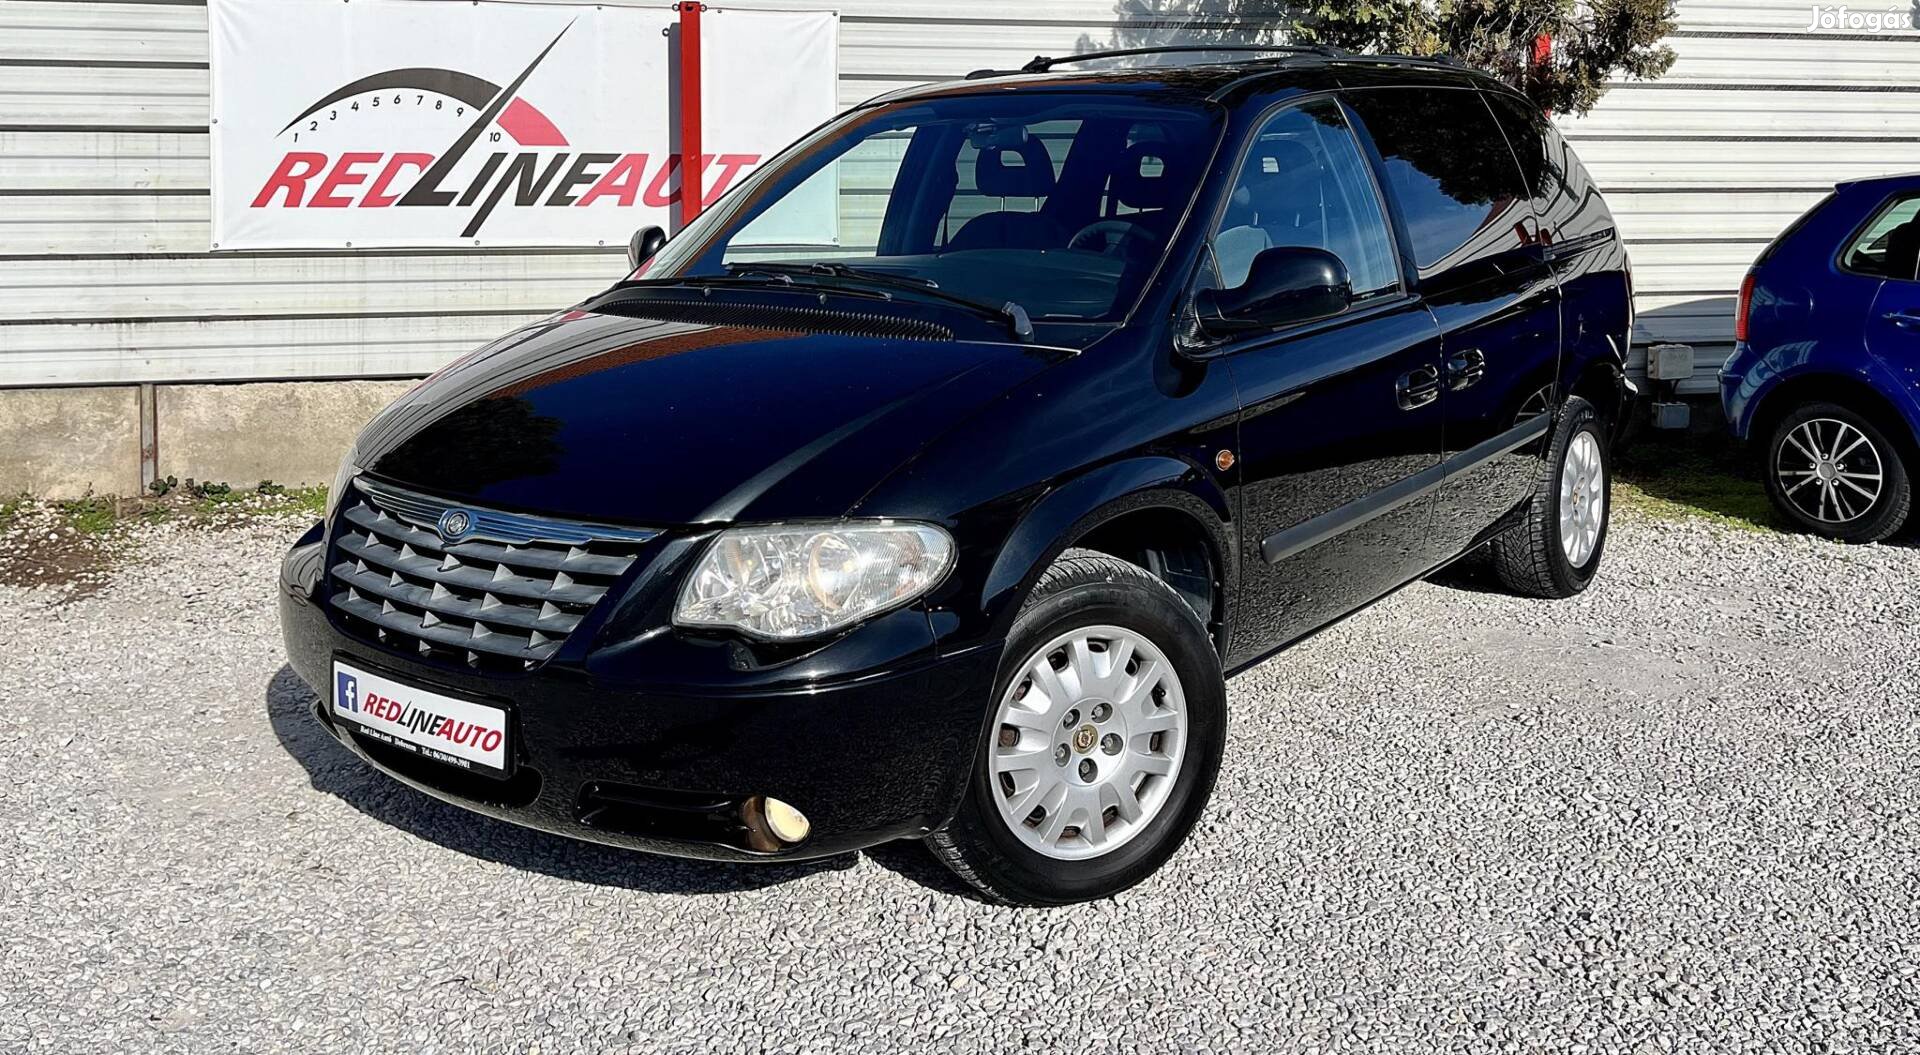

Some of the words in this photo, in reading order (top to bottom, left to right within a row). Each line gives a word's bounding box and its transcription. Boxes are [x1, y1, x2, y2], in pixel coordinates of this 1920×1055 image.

[294, 133, 299, 143] 1
[310, 121, 318, 131] 2
[329, 111, 337, 121] 3
[351, 102, 360, 111] 4
[373, 97, 380, 107] 5
[394, 95, 401, 105] 6
[416, 95, 424, 106] 7
[435, 100, 442, 110] 8
[456, 107, 464, 117] 9
[489, 132, 501, 143] 10
[363, 692, 503, 752] REDLINEAUTO
